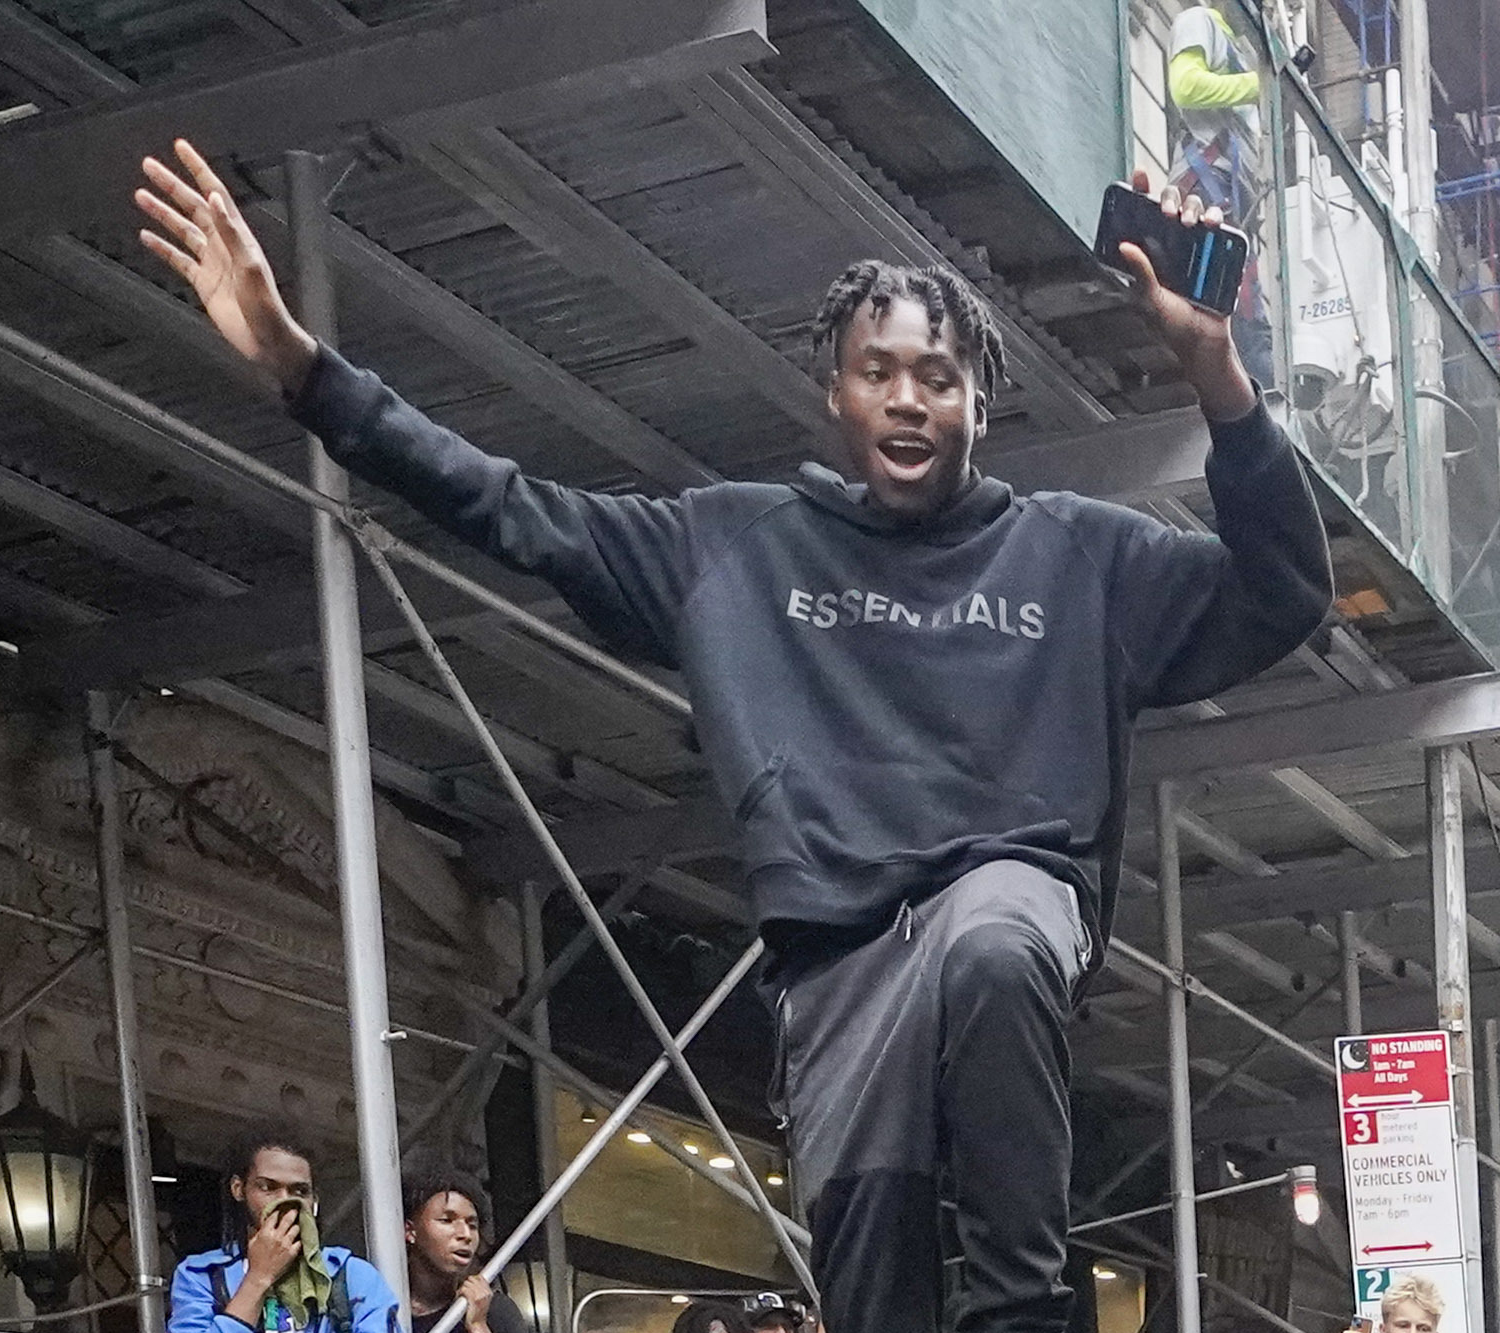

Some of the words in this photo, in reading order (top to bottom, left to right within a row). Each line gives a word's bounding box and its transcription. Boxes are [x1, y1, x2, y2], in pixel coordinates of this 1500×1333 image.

[786, 587, 1046, 640] ESSENIALS
[1371, 1043, 1388, 1055] NO
[1389, 1039, 1443, 1055] STANDING
[1373, 1061, 1391, 1071] 1am
[1397, 1059, 1416, 1070] 7am
[1374, 1072, 1386, 1084] All
[1387, 1072, 1409, 1084] Days
[1352, 1113, 1371, 1142] 3
[1382, 1122, 1418, 1131] metered
[1383, 1135, 1415, 1145] parking
[1352, 1154, 1434, 1171] COMMERCIAL
[1353, 1172, 1413, 1187] VEHICLES
[1416, 1169, 1448, 1183] ONLY
[1355, 1196, 1393, 1207] Monday
[1403, 1193, 1433, 1204] Friday
[1357, 1210, 1378, 1220] 7am
[1387, 1209, 1410, 1219] 6pm
[1365, 1270, 1383, 1299] 2
